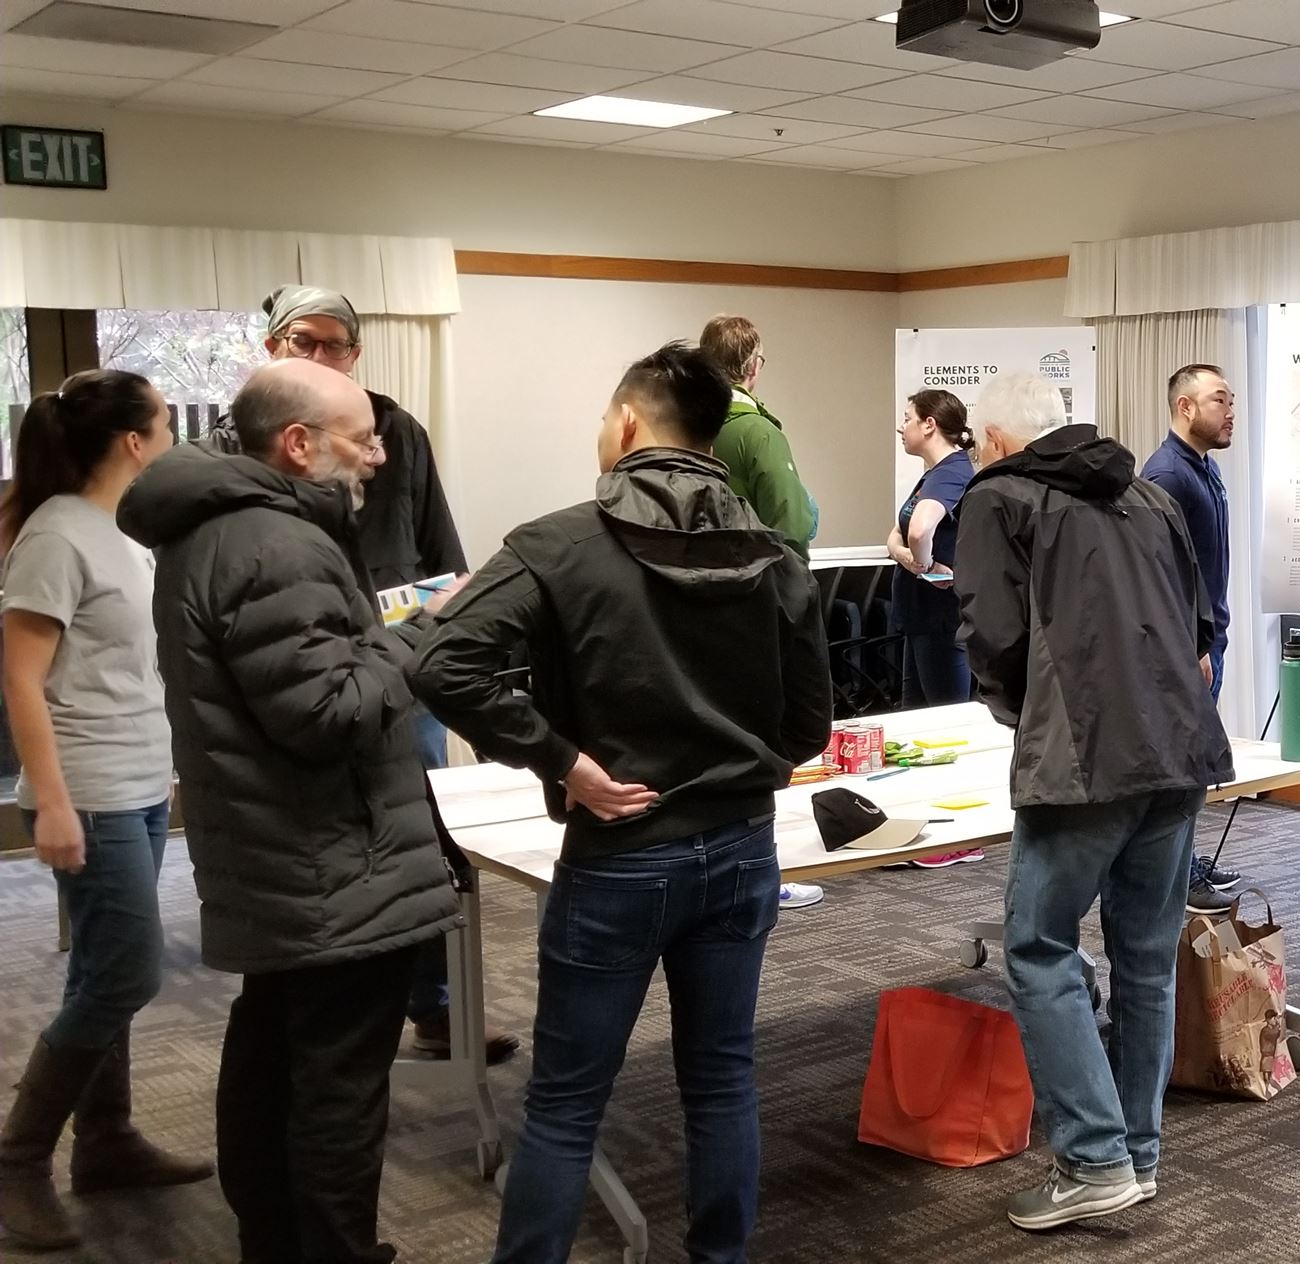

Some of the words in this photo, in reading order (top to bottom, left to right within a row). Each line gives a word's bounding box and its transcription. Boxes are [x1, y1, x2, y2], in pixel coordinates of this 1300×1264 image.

[21, 133, 91, 182] EXIT
[924, 366, 979, 375] ELEMENTS
[984, 365, 998, 374] TO
[924, 376, 980, 385] CONSIDER
